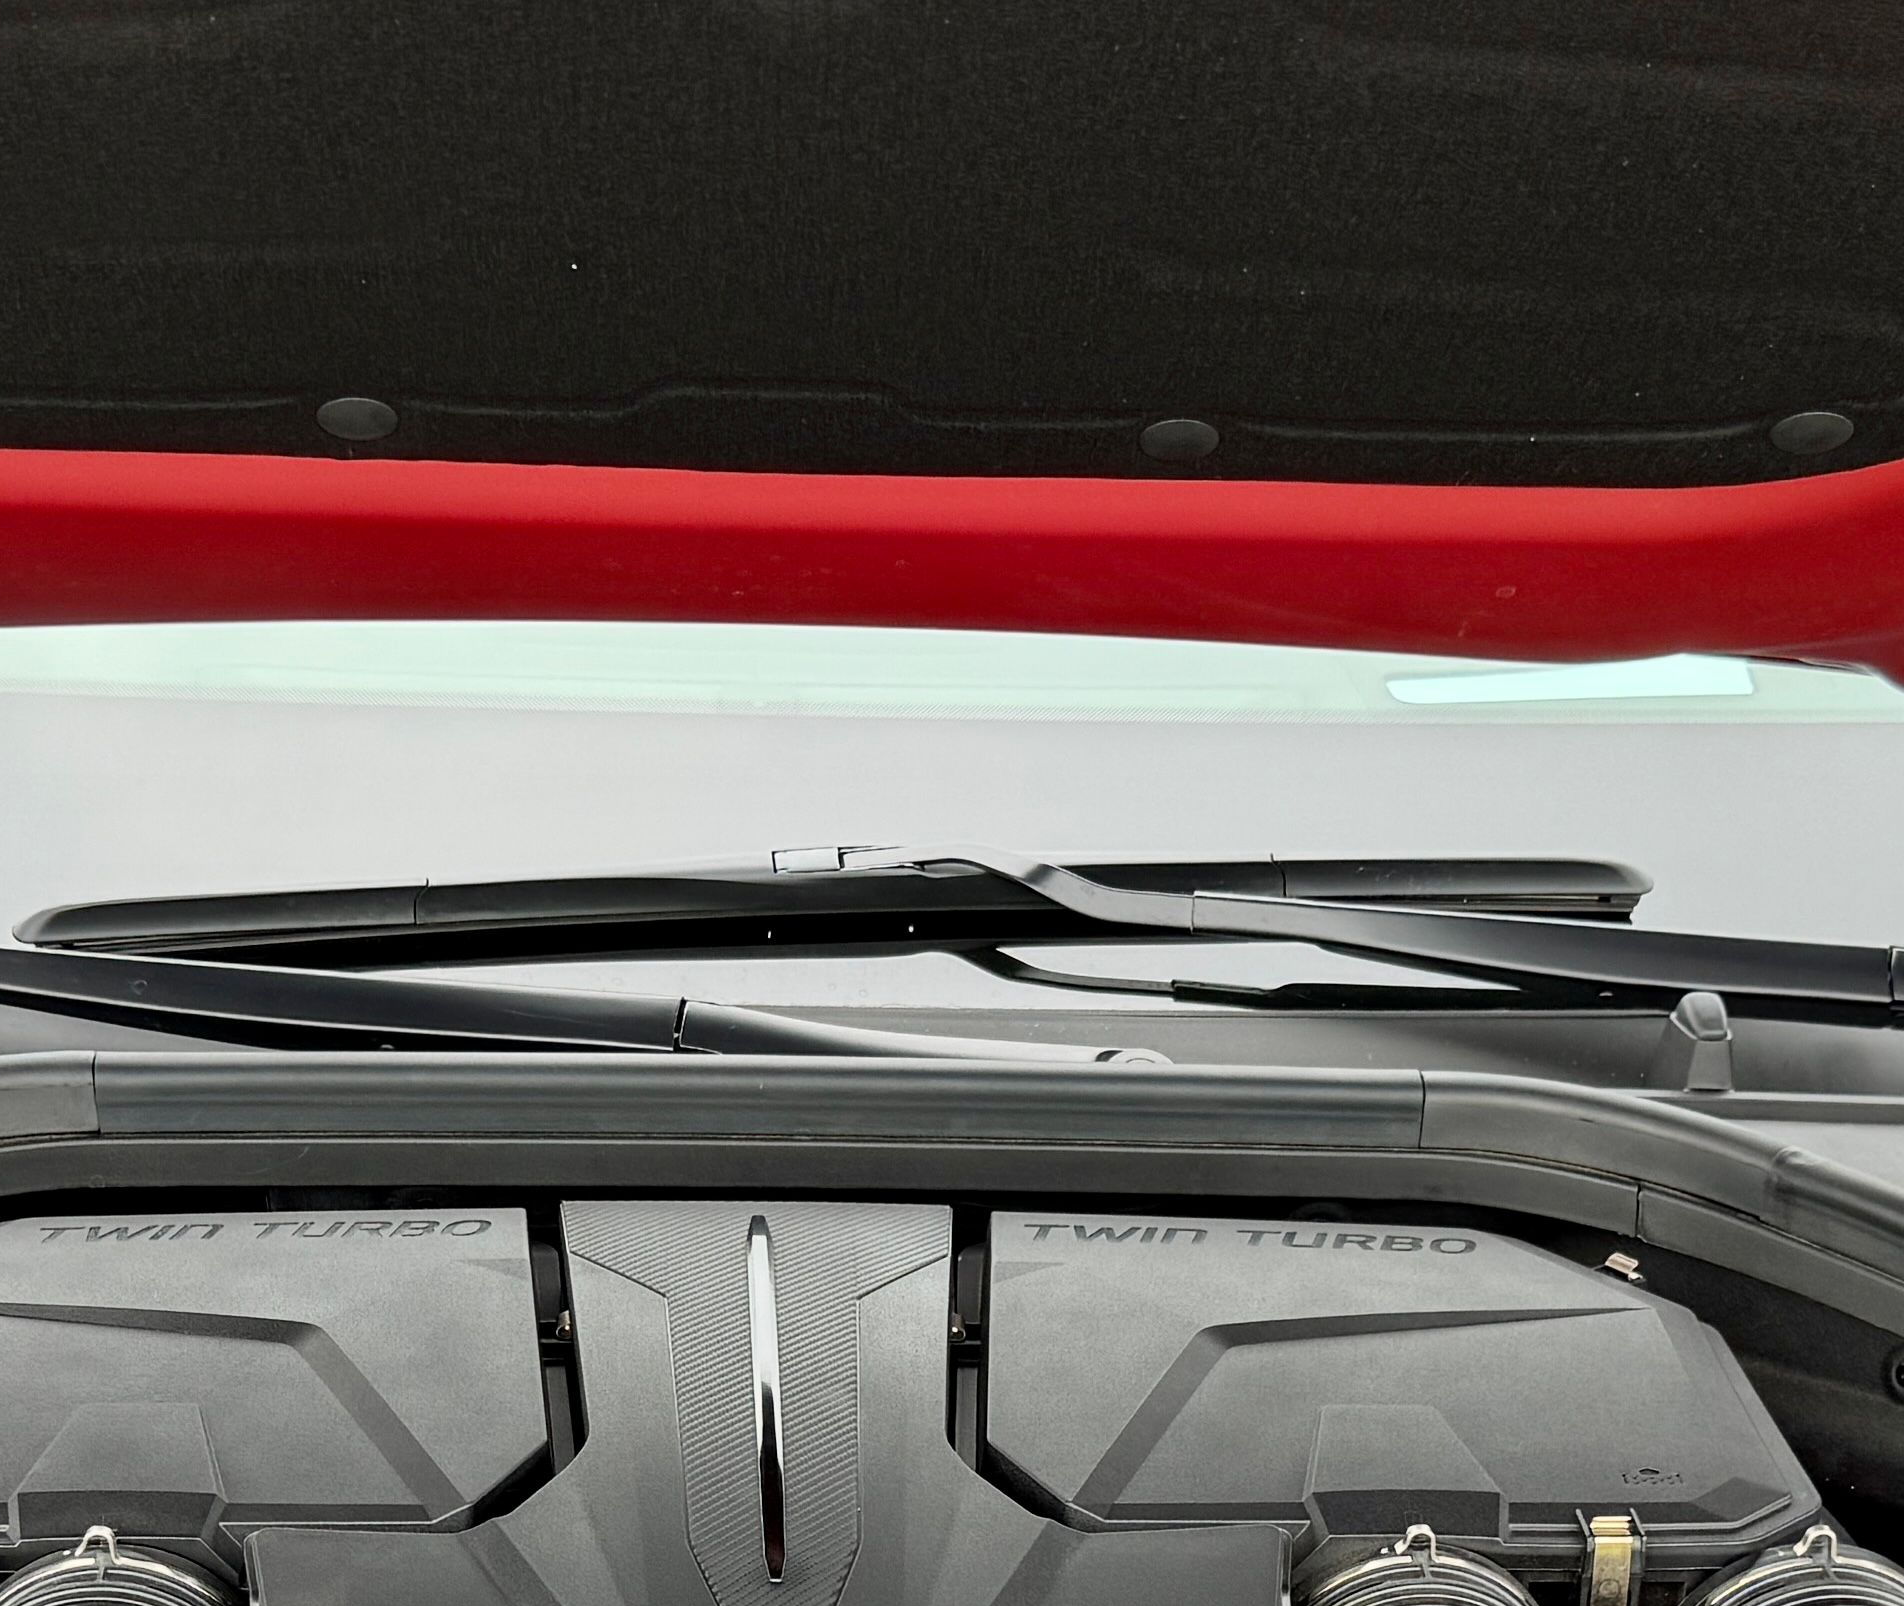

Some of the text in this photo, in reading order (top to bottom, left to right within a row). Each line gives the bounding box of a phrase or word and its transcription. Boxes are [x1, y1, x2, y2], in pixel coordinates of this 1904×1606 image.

[39, 1219, 493, 1244] TWIN TURBO
[1024, 1223, 1478, 1255] TWIN TURBO
